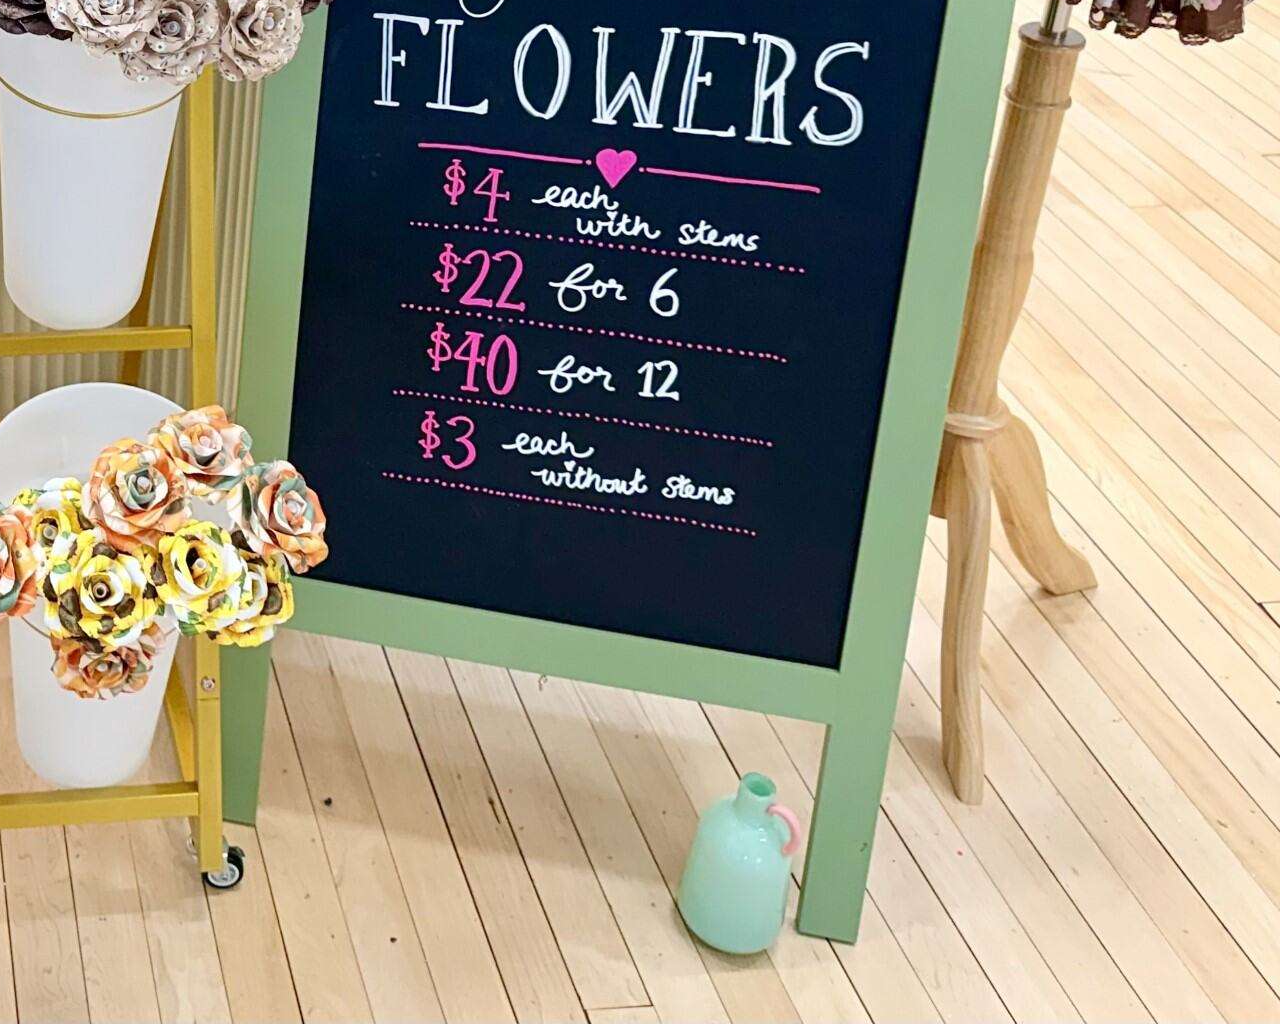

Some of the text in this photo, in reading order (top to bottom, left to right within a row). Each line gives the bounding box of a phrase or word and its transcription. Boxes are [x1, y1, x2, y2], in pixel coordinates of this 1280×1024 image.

[372, 12, 870, 147] FLOWERS
[443, 158, 620, 224] $4 each
[576, 210, 760, 252] with stems
[431, 242, 680, 317] $22 for 6
[427, 322, 680, 402] $40 for 12
[418, 410, 595, 470] $3 each
[530, 460, 736, 506] without stems
